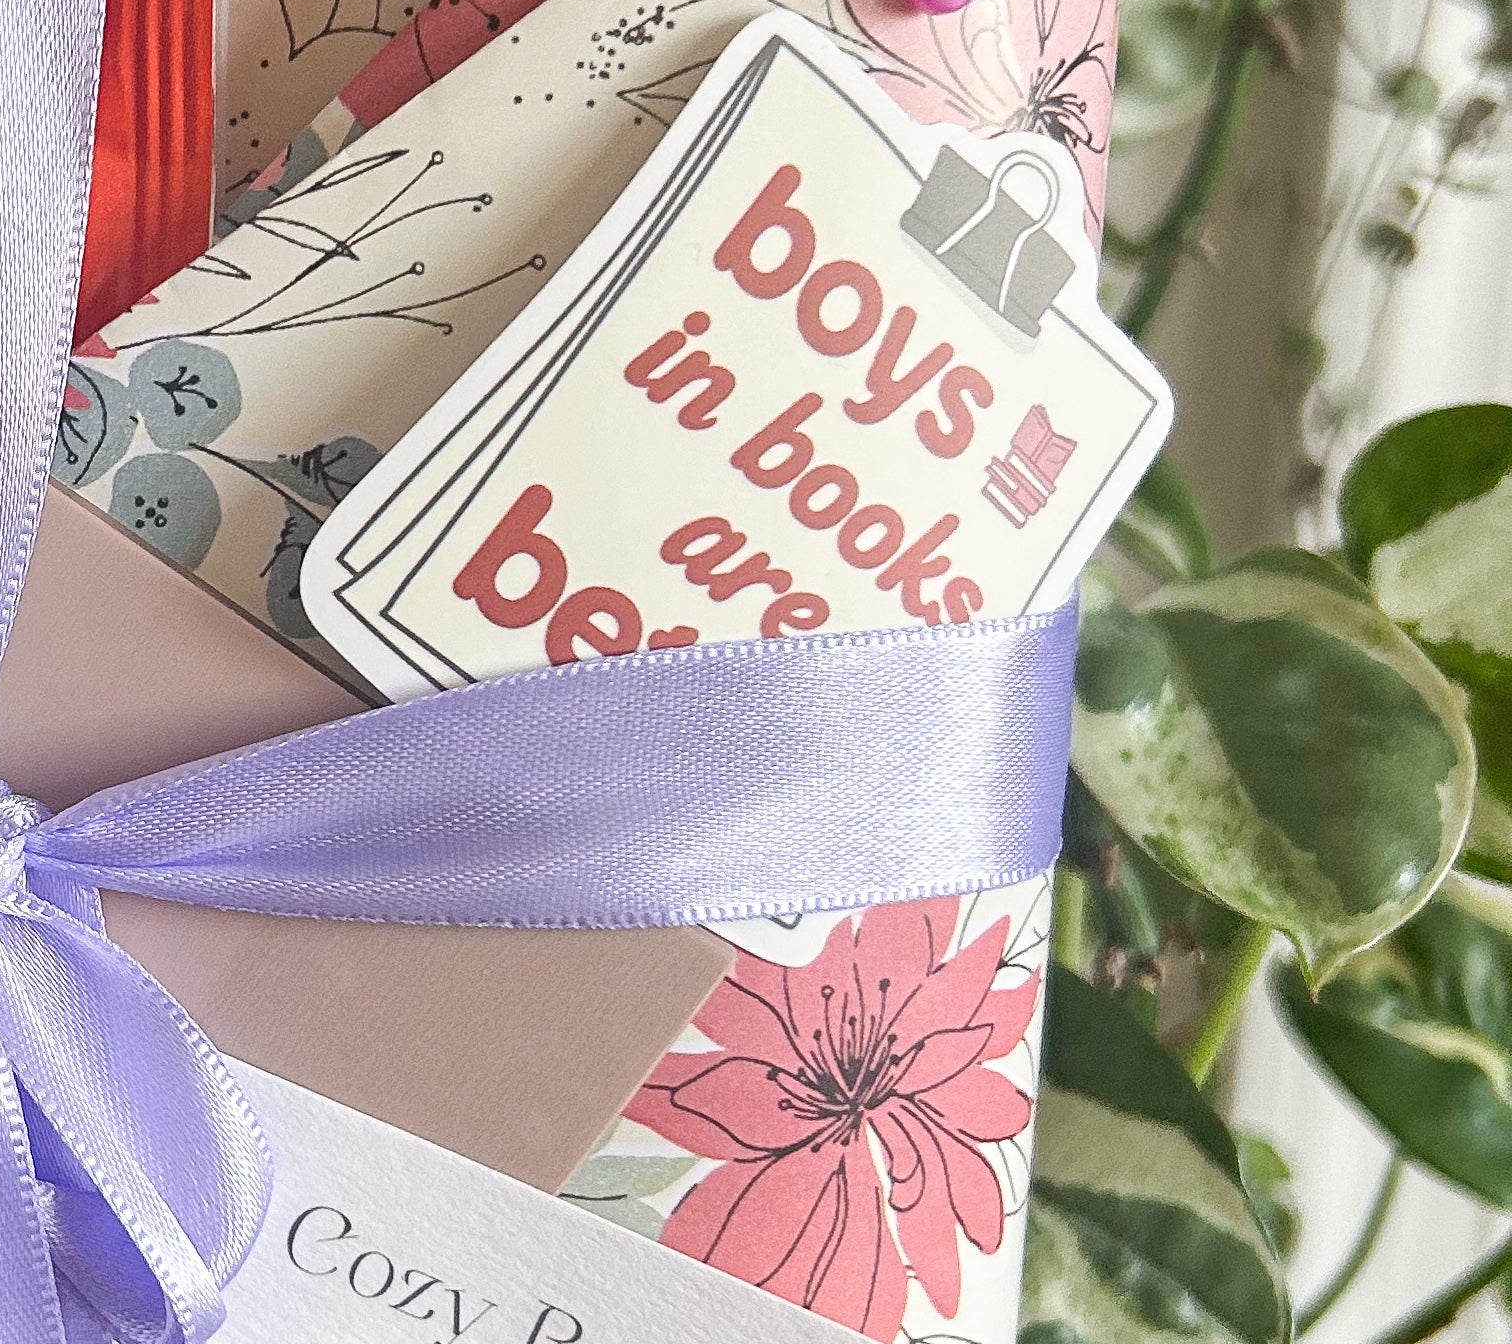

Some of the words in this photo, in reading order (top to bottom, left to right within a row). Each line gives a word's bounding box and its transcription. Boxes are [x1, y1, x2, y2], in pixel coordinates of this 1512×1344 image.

[624, 310, 737, 431] in
[714, 164, 995, 458] boys
[660, 516, 830, 639] are
